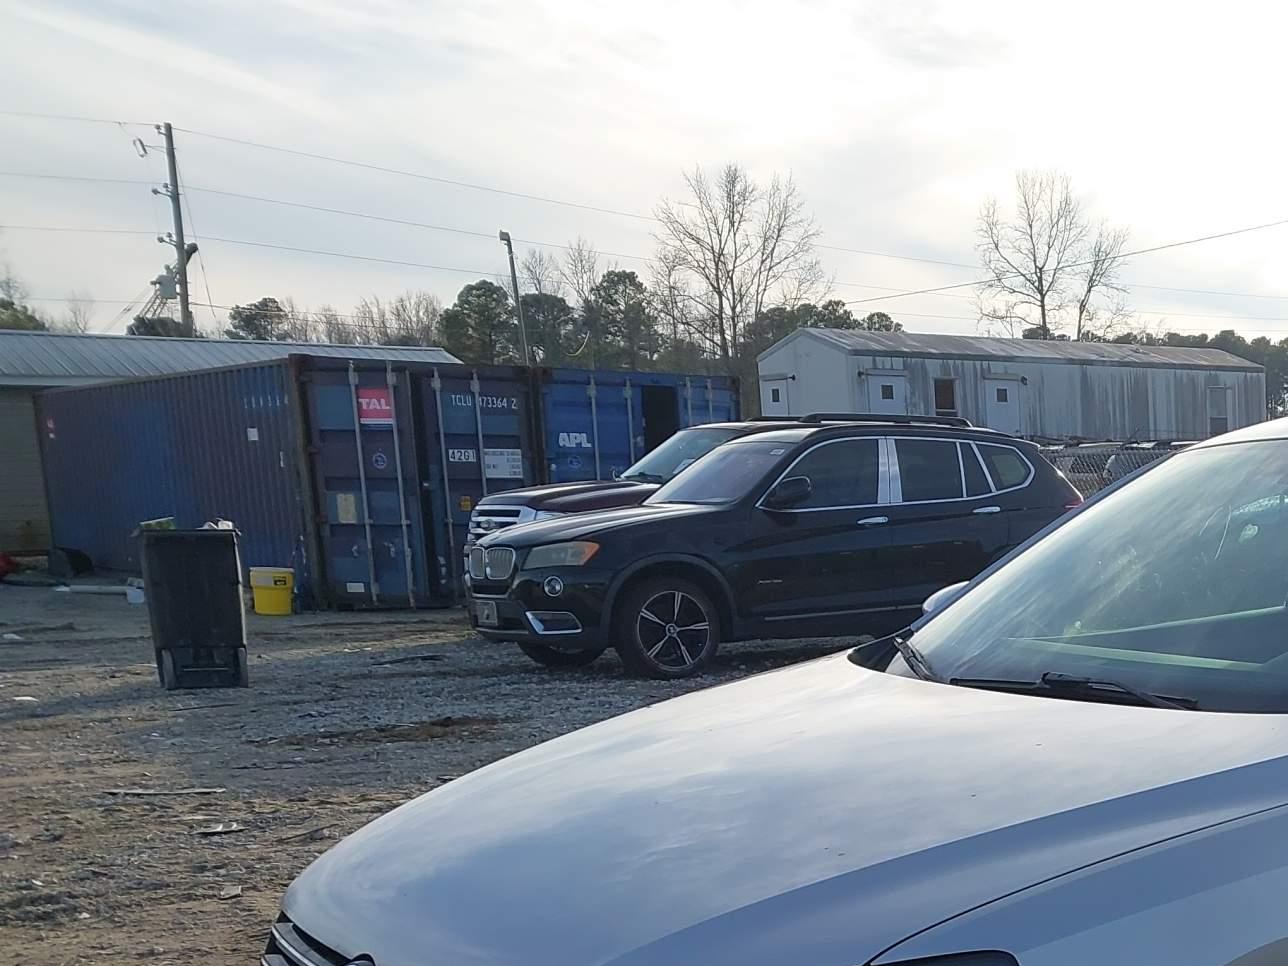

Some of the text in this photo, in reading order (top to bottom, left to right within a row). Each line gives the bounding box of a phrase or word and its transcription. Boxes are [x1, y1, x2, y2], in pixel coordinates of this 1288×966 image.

[359, 398, 391, 410] TAL
[451, 394, 472, 407] TCLU
[511, 398, 519, 409] 2
[559, 432, 592, 448] APL
